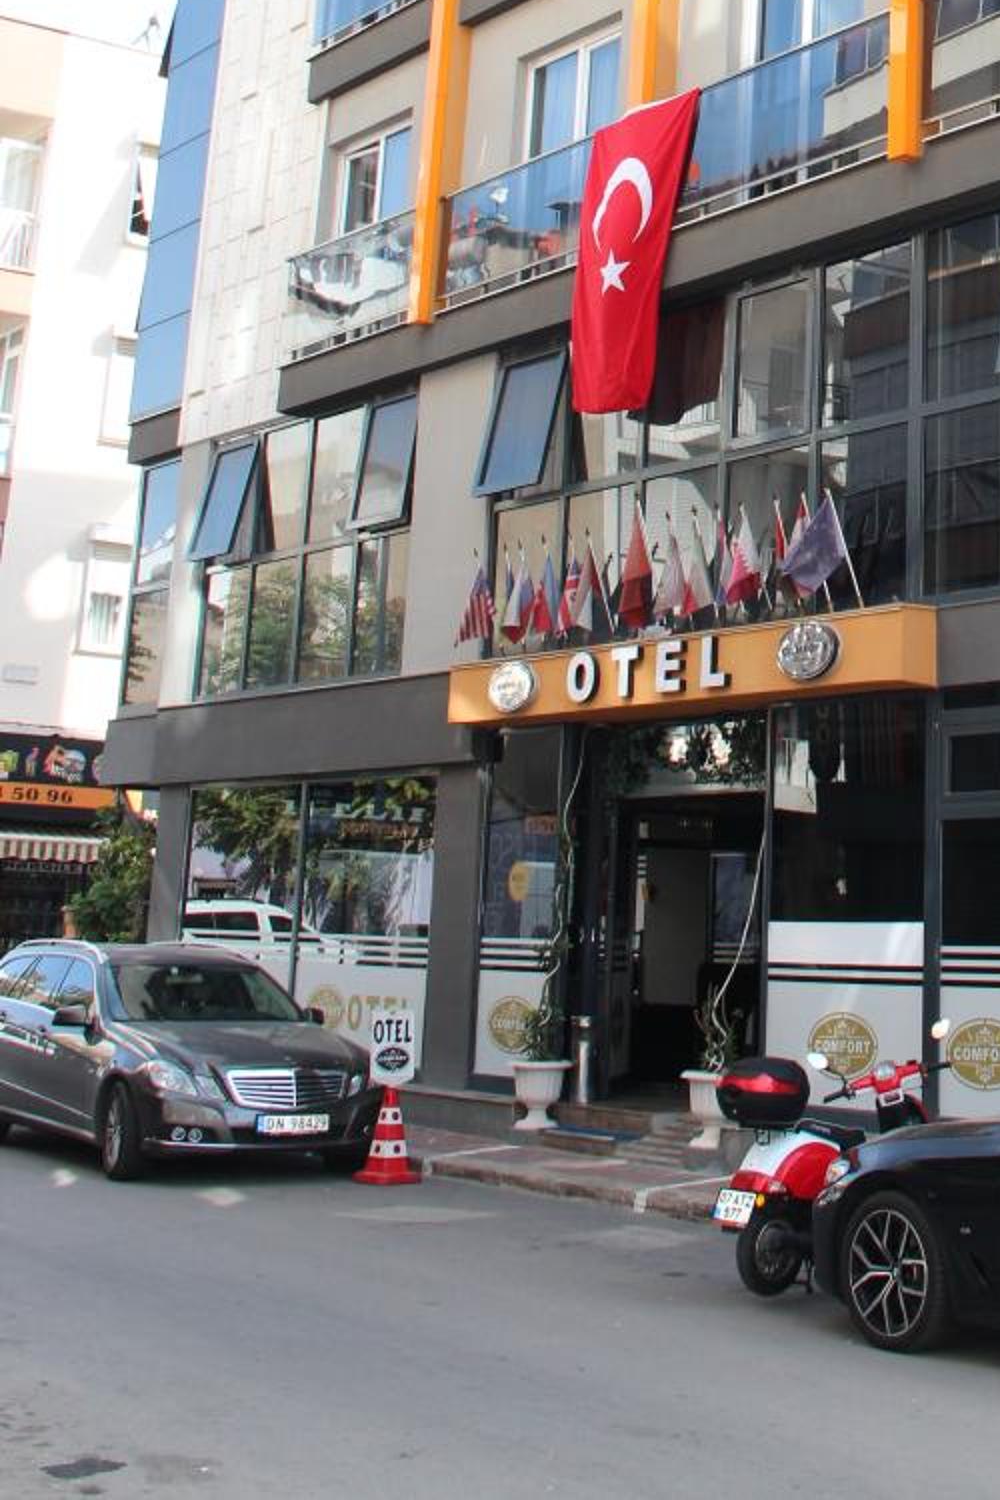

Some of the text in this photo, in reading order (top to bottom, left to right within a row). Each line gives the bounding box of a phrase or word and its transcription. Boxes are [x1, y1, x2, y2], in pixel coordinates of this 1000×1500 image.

[566, 635, 727, 704] OTEL
[373, 1019, 412, 1044] OTEL
[814, 1038, 871, 1051] COMFORT
